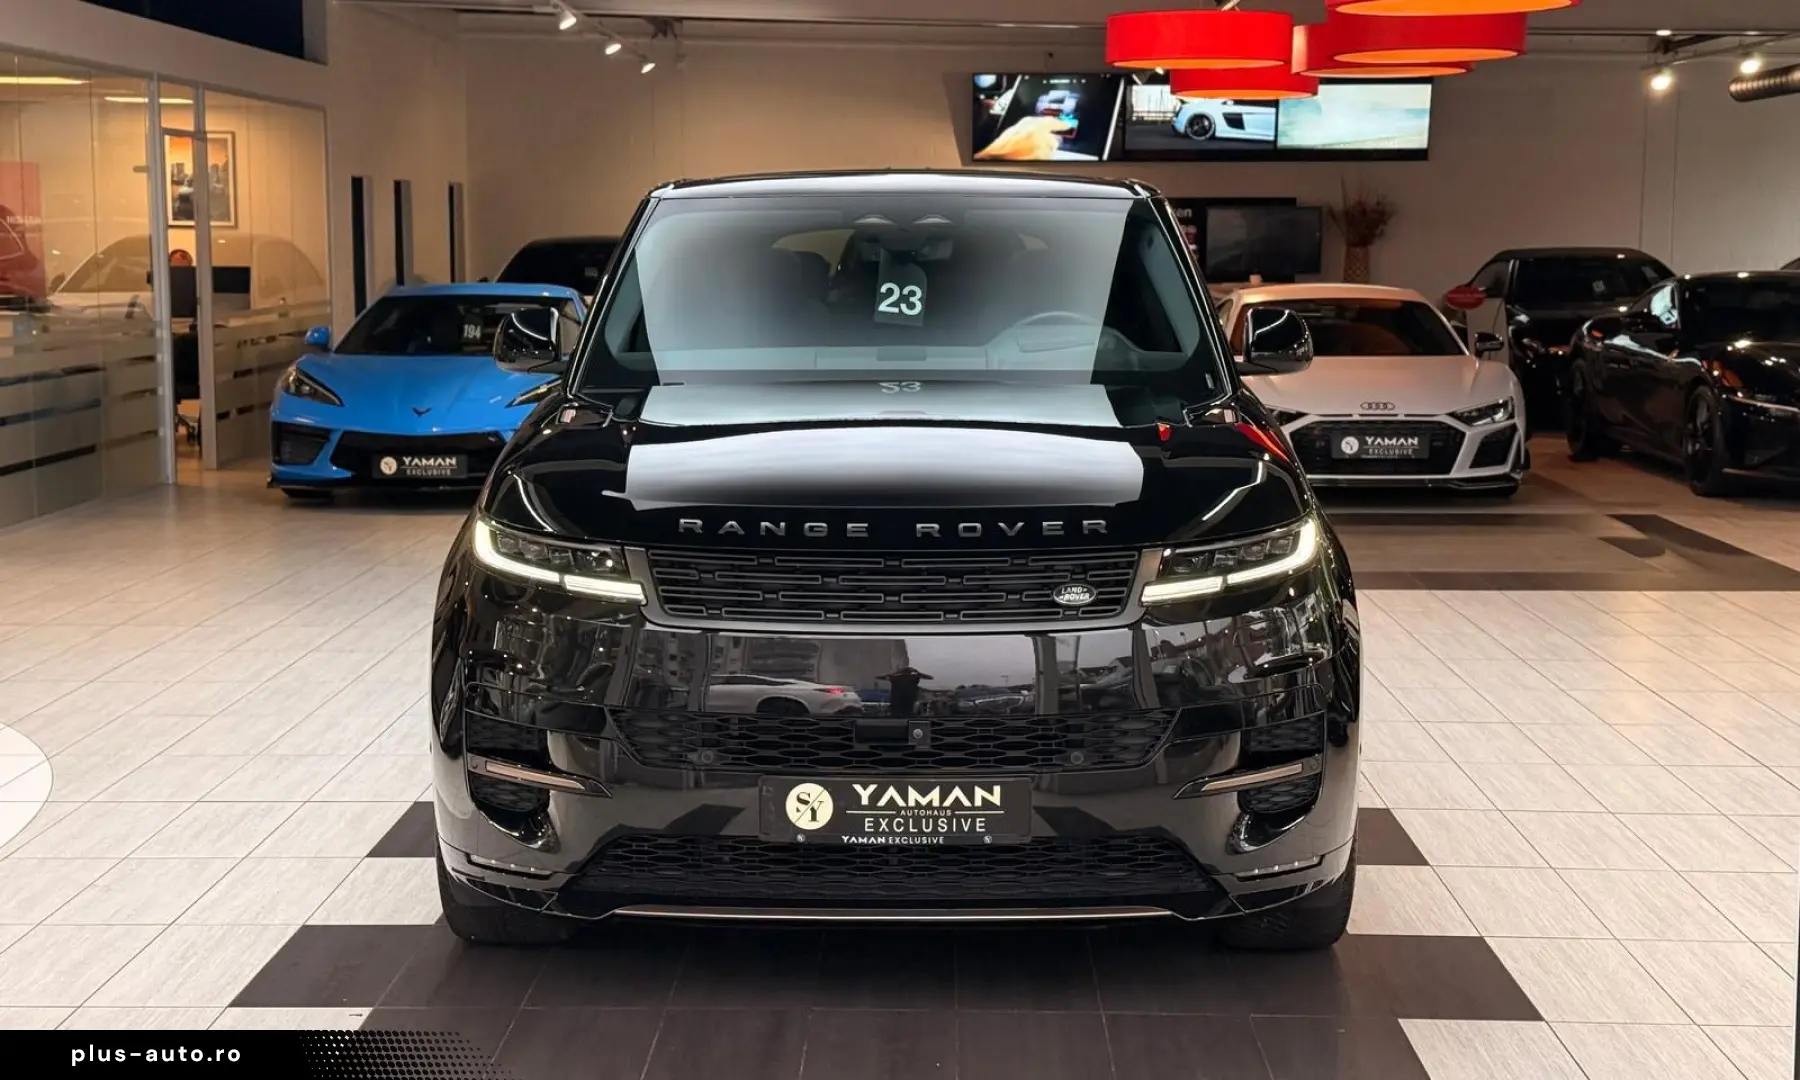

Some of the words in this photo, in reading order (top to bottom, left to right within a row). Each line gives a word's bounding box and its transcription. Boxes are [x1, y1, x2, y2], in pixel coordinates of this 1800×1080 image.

[878, 282, 923, 316] 23
[463, 324, 481, 339] 194
[1365, 436, 1419, 446] YAMAN
[402, 456, 457, 466] YAMAN
[678, 518, 869, 538] RANGE
[915, 519, 1108, 538] ROVER
[852, 784, 1001, 807] YAMAN
[900, 809, 952, 817] AUTOHAUS
[864, 817, 987, 833] EXCLUSIVE
[841, 835, 887, 845] YAMAN
[888, 836, 945, 845] EXCLUSIVE
